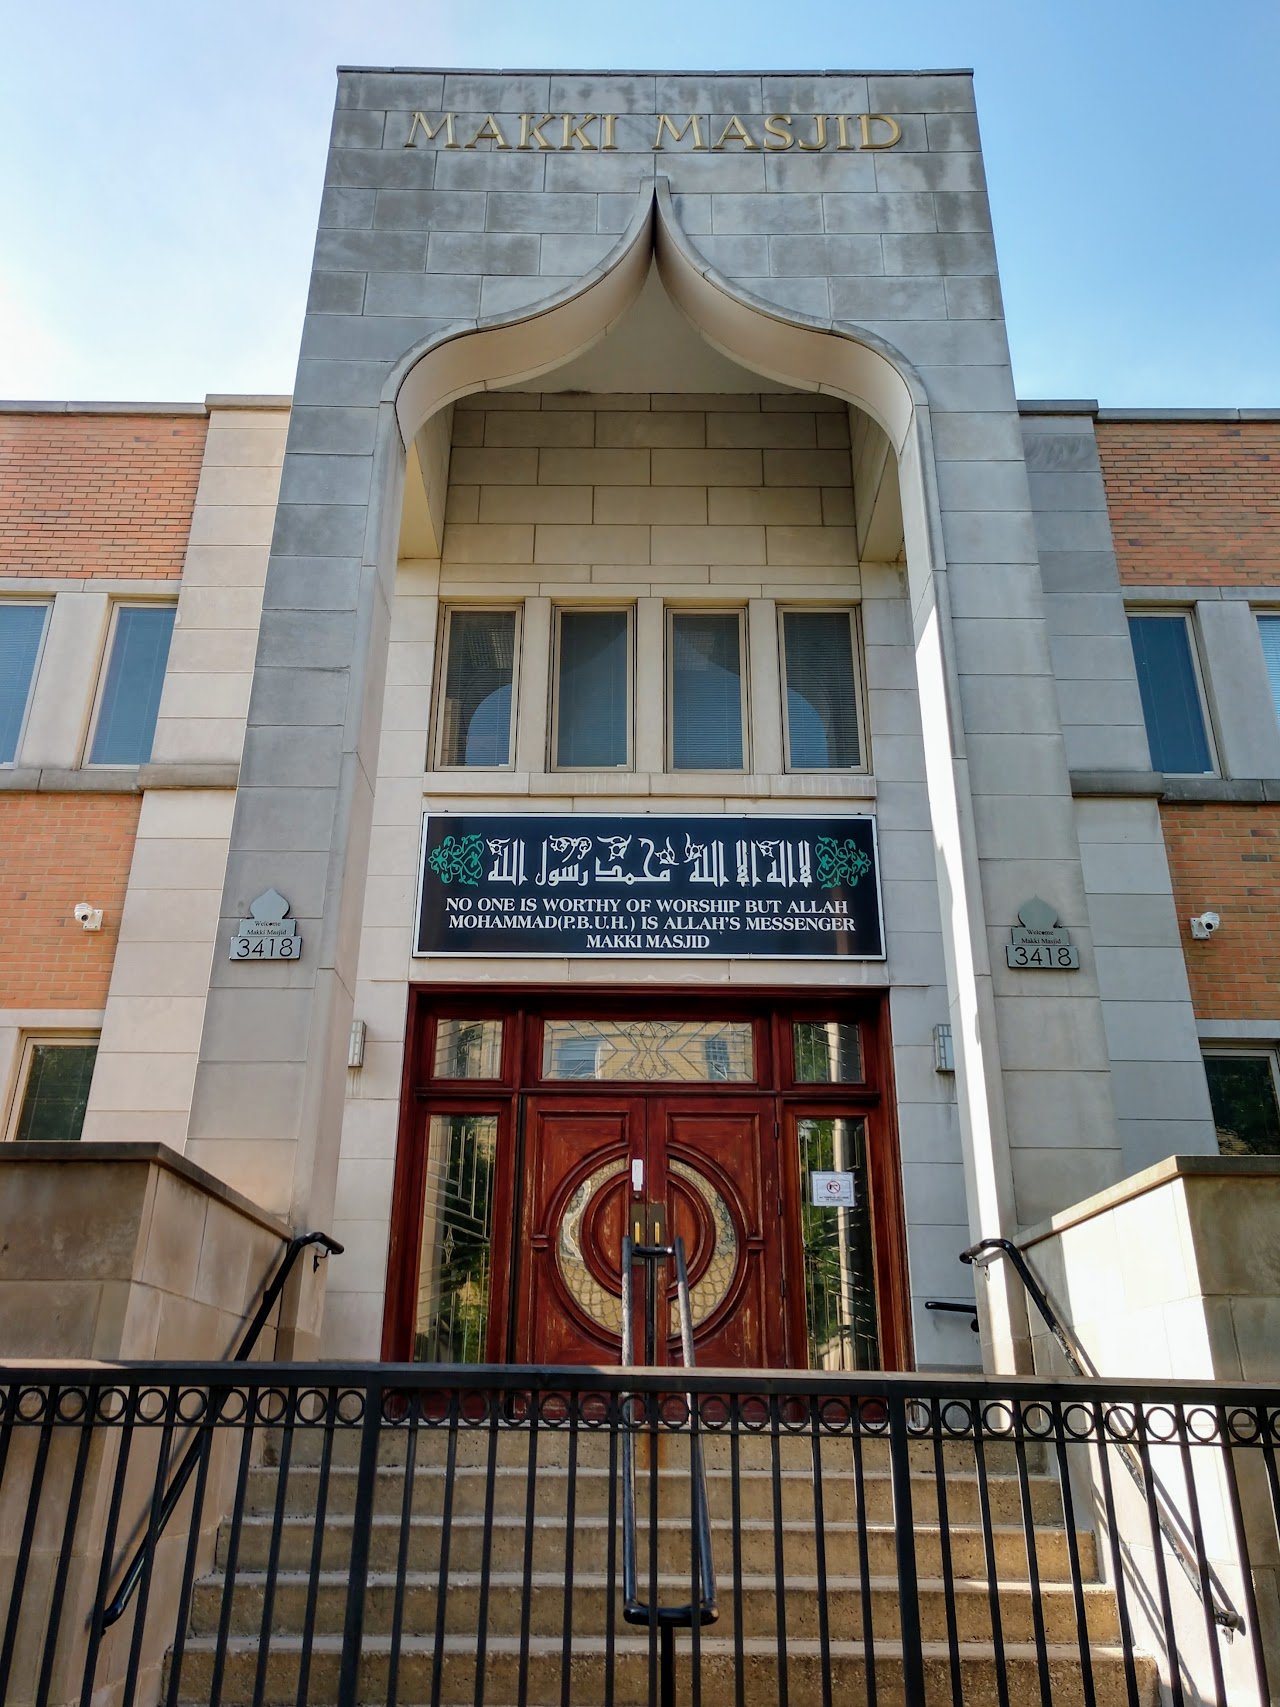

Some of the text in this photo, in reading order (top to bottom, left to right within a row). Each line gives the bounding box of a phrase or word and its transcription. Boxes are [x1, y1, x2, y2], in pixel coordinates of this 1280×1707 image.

[403, 112, 902, 150] MAKKI MASJID
[445, 897, 848, 914] NO ONE IS WORTHY OF WORSHIP BUT ALLAH
[641, 916, 659, 930] IS
[663, 916, 741, 931] ALLAH'S
[745, 917, 856, 931] MESSENGER
[236, 938, 293, 958] 3418
[586, 934, 710, 948] MAKKI MASJID
[1014, 946, 1072, 967] 3418
